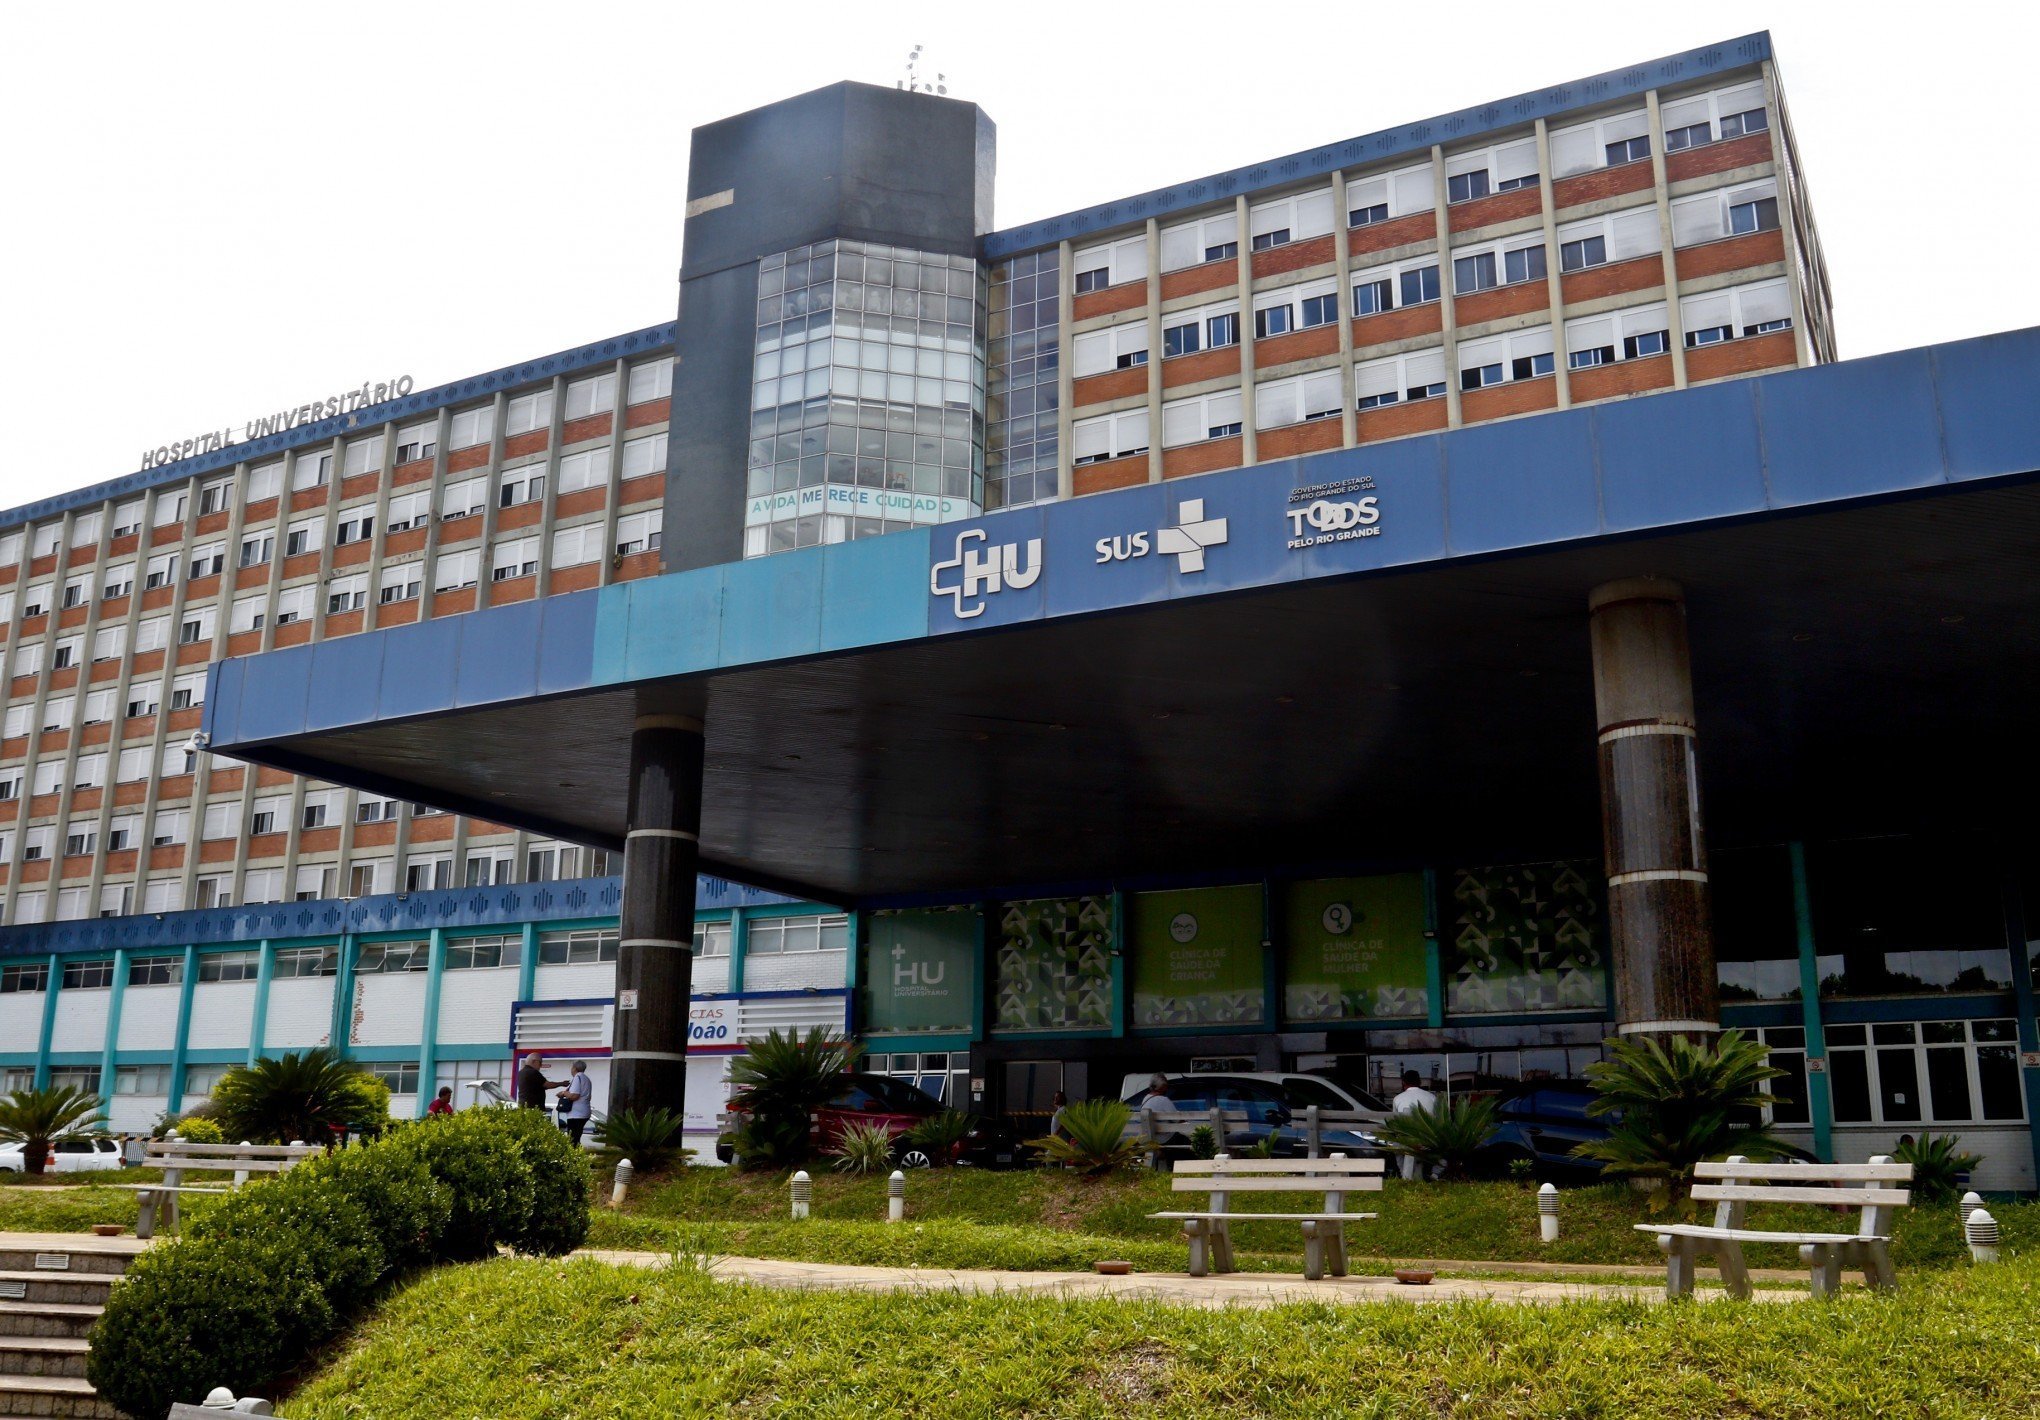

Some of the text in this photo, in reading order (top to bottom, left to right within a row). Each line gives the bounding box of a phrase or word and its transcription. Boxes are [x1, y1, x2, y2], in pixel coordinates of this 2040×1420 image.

[141, 374, 414, 471] HOSPITAL UNIVERSITÁRIO
[1288, 495, 1300, 503] DO
[1300, 492, 1314, 500] RIO
[1316, 487, 1347, 498] GRANDE
[1348, 484, 1360, 492] DO
[1291, 475, 1372, 495] GOVERNO DO ESTADO
[752, 501, 762, 513] A
[763, 495, 796, 511] VIDA
[875, 494, 952, 513] CUIDADO
[1095, 531, 1150, 564] SUS
[1287, 526, 1381, 549] PELO RIO GRANDE
[964, 538, 1042, 597] HU
[1369, 939, 1384, 949] DE
[894, 961, 945, 986] HU
